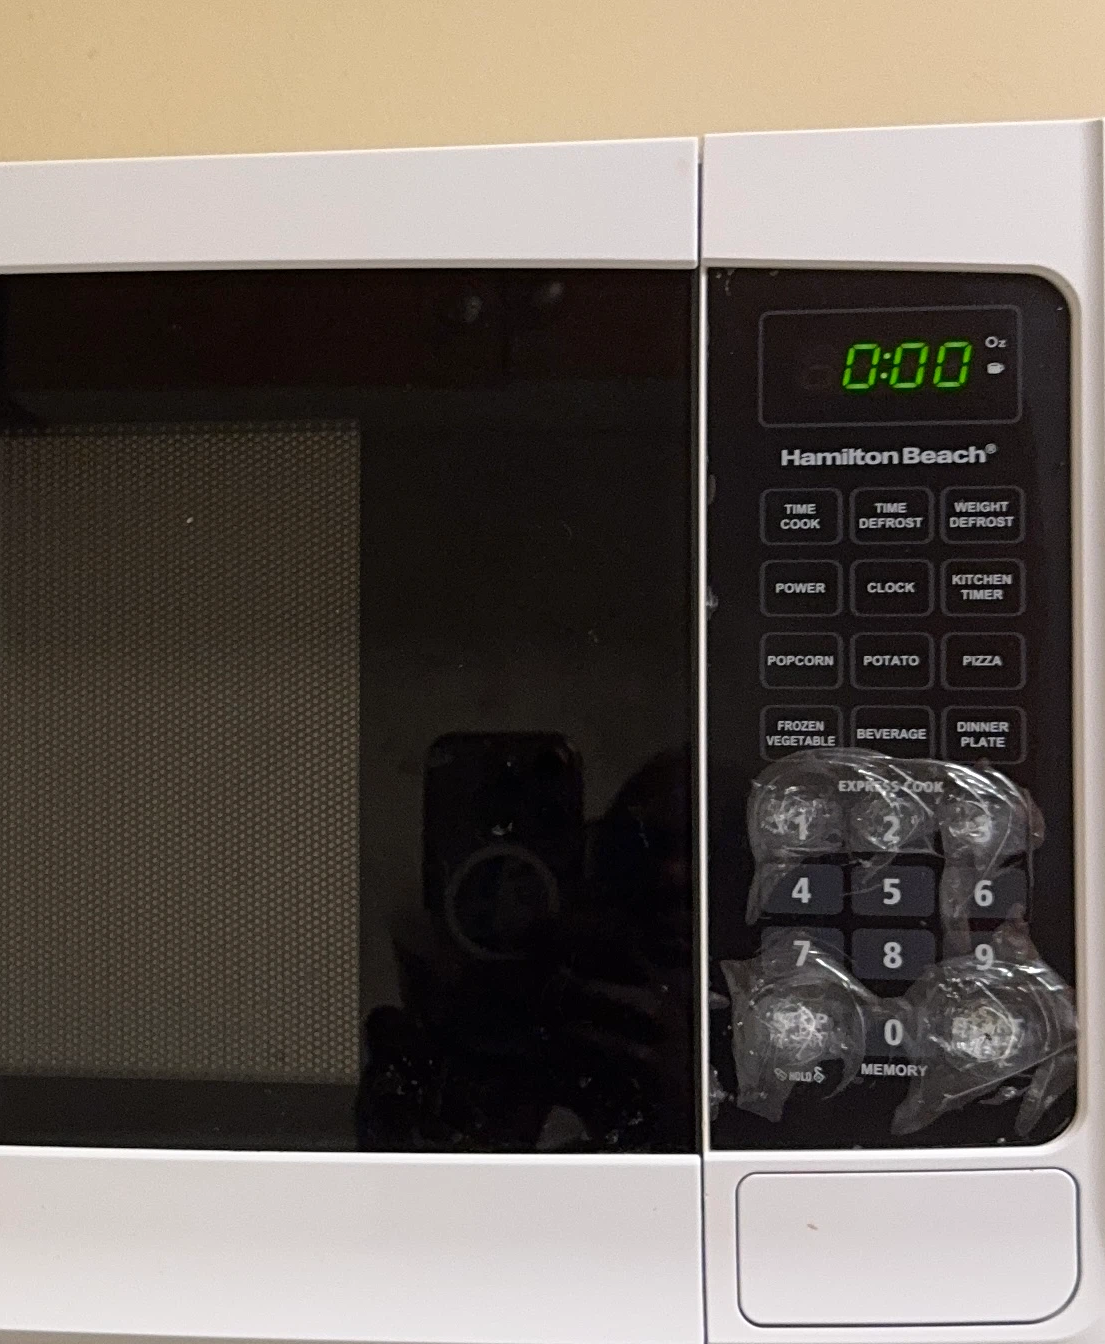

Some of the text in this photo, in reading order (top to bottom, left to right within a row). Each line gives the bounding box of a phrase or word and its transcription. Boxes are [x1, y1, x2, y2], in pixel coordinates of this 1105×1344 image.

[985, 336, 1007, 349] Oz
[843, 342, 972, 390] 0:00
[780, 449, 899, 466] Hamilton
[784, 504, 817, 515] TIME
[875, 502, 907, 513] TIME
[954, 501, 1009, 514] WEIGHT
[780, 518, 821, 529] COOK
[859, 517, 922, 529] DEFROST
[950, 516, 1014, 528] DEFROST
[952, 574, 1012, 586] KITCHEN
[775, 583, 825, 594] POWER
[867, 582, 915, 594] CLOCK
[961, 589, 1003, 601] TIMER
[767, 655, 834, 666] POPCORN
[863, 655, 919, 667] POTATO
[962, 655, 1002, 666] PIZZA
[777, 720, 824, 732] FROZEN
[957, 721, 1009, 733] DINNER
[857, 728, 926, 740] BEVERAGE
[766, 735, 835, 747] VEGETABLE
[960, 736, 1005, 748] PLATE
[839, 780, 943, 793] EXPRESS COOK
[795, 815, 808, 840] 1
[883, 815, 900, 842] 2
[791, 878, 811, 903] 4
[883, 878, 901, 904] 5
[975, 880, 993, 906] 6
[793, 940, 810, 966] 7
[883, 942, 901, 968] 8
[975, 944, 993, 969] 9
[884, 1018, 903, 1046] 0
[861, 1064, 927, 1077] MEMORY
